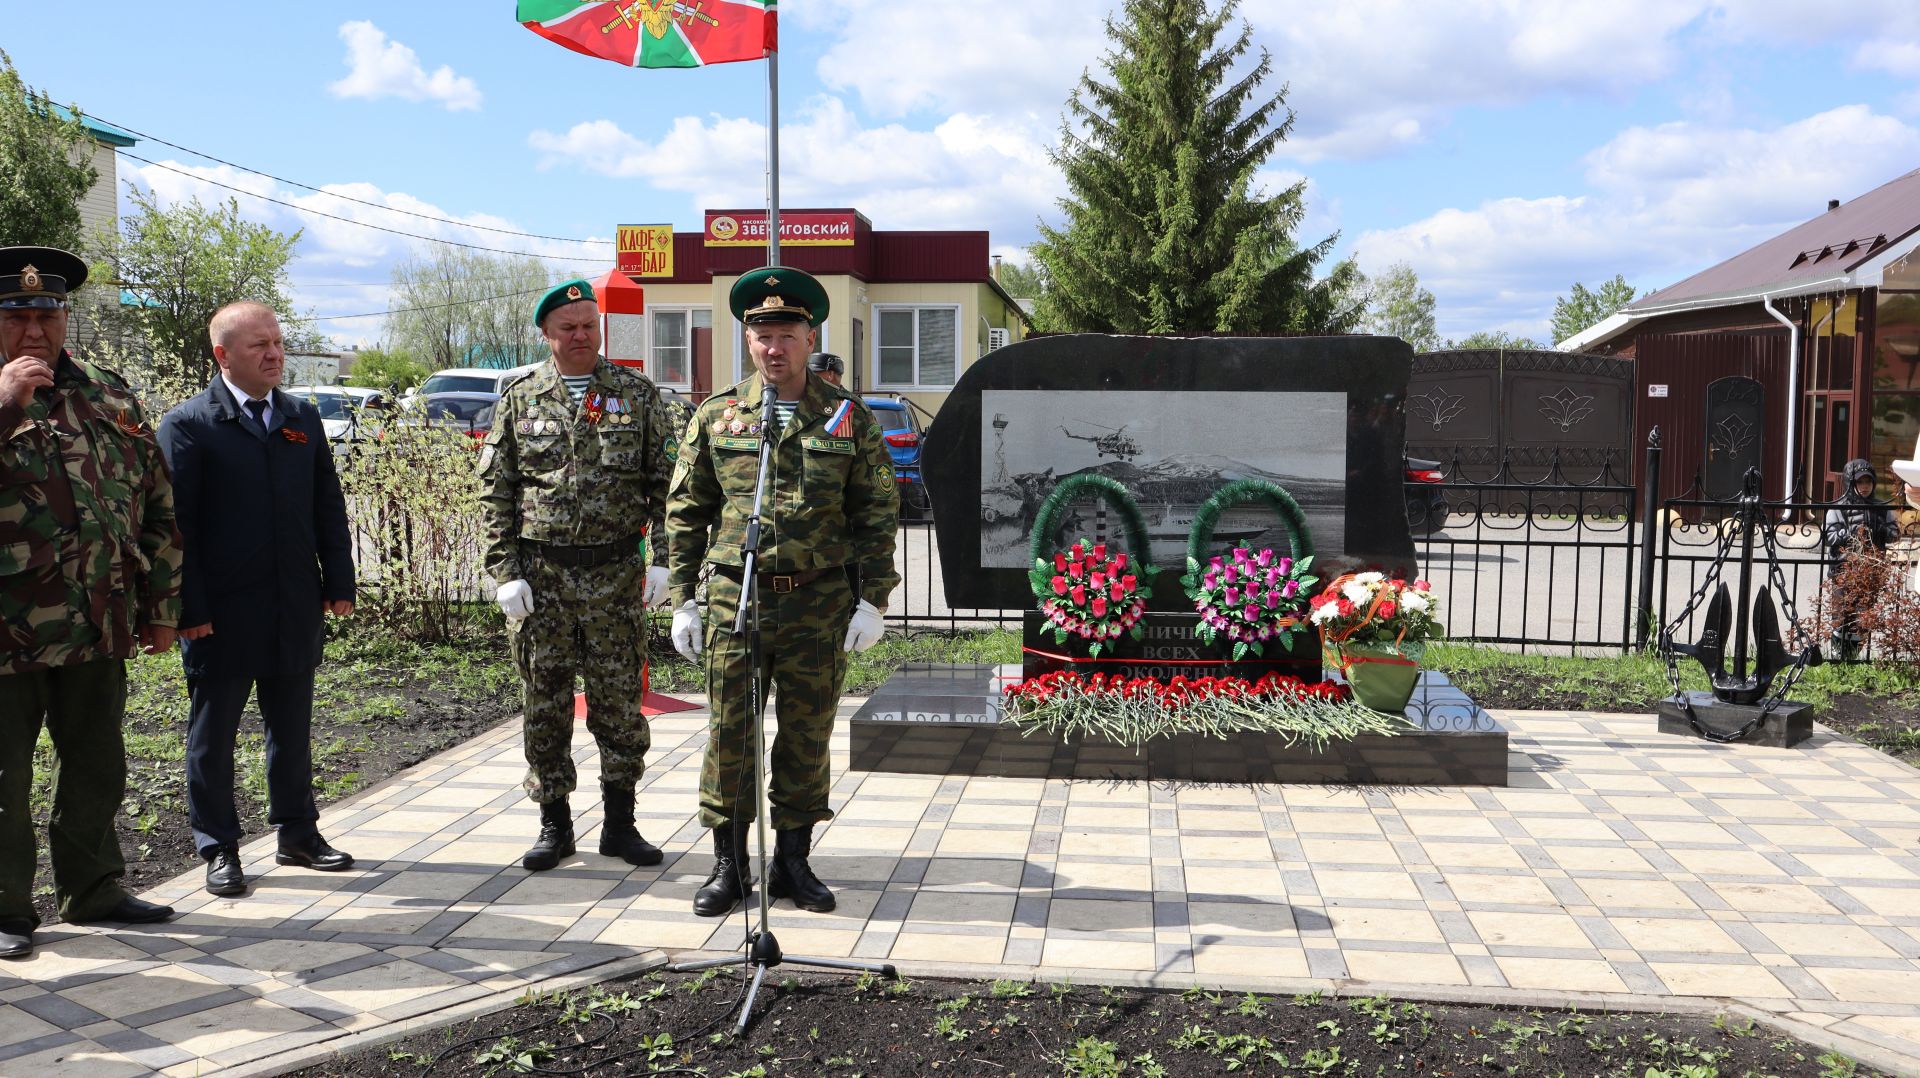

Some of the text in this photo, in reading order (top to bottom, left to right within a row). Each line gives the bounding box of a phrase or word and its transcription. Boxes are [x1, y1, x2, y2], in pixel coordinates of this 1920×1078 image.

[620, 229, 655, 250] КАФЕ
[642, 251, 666, 273] БАР
[1143, 646, 1201, 659] ВСЕХ
